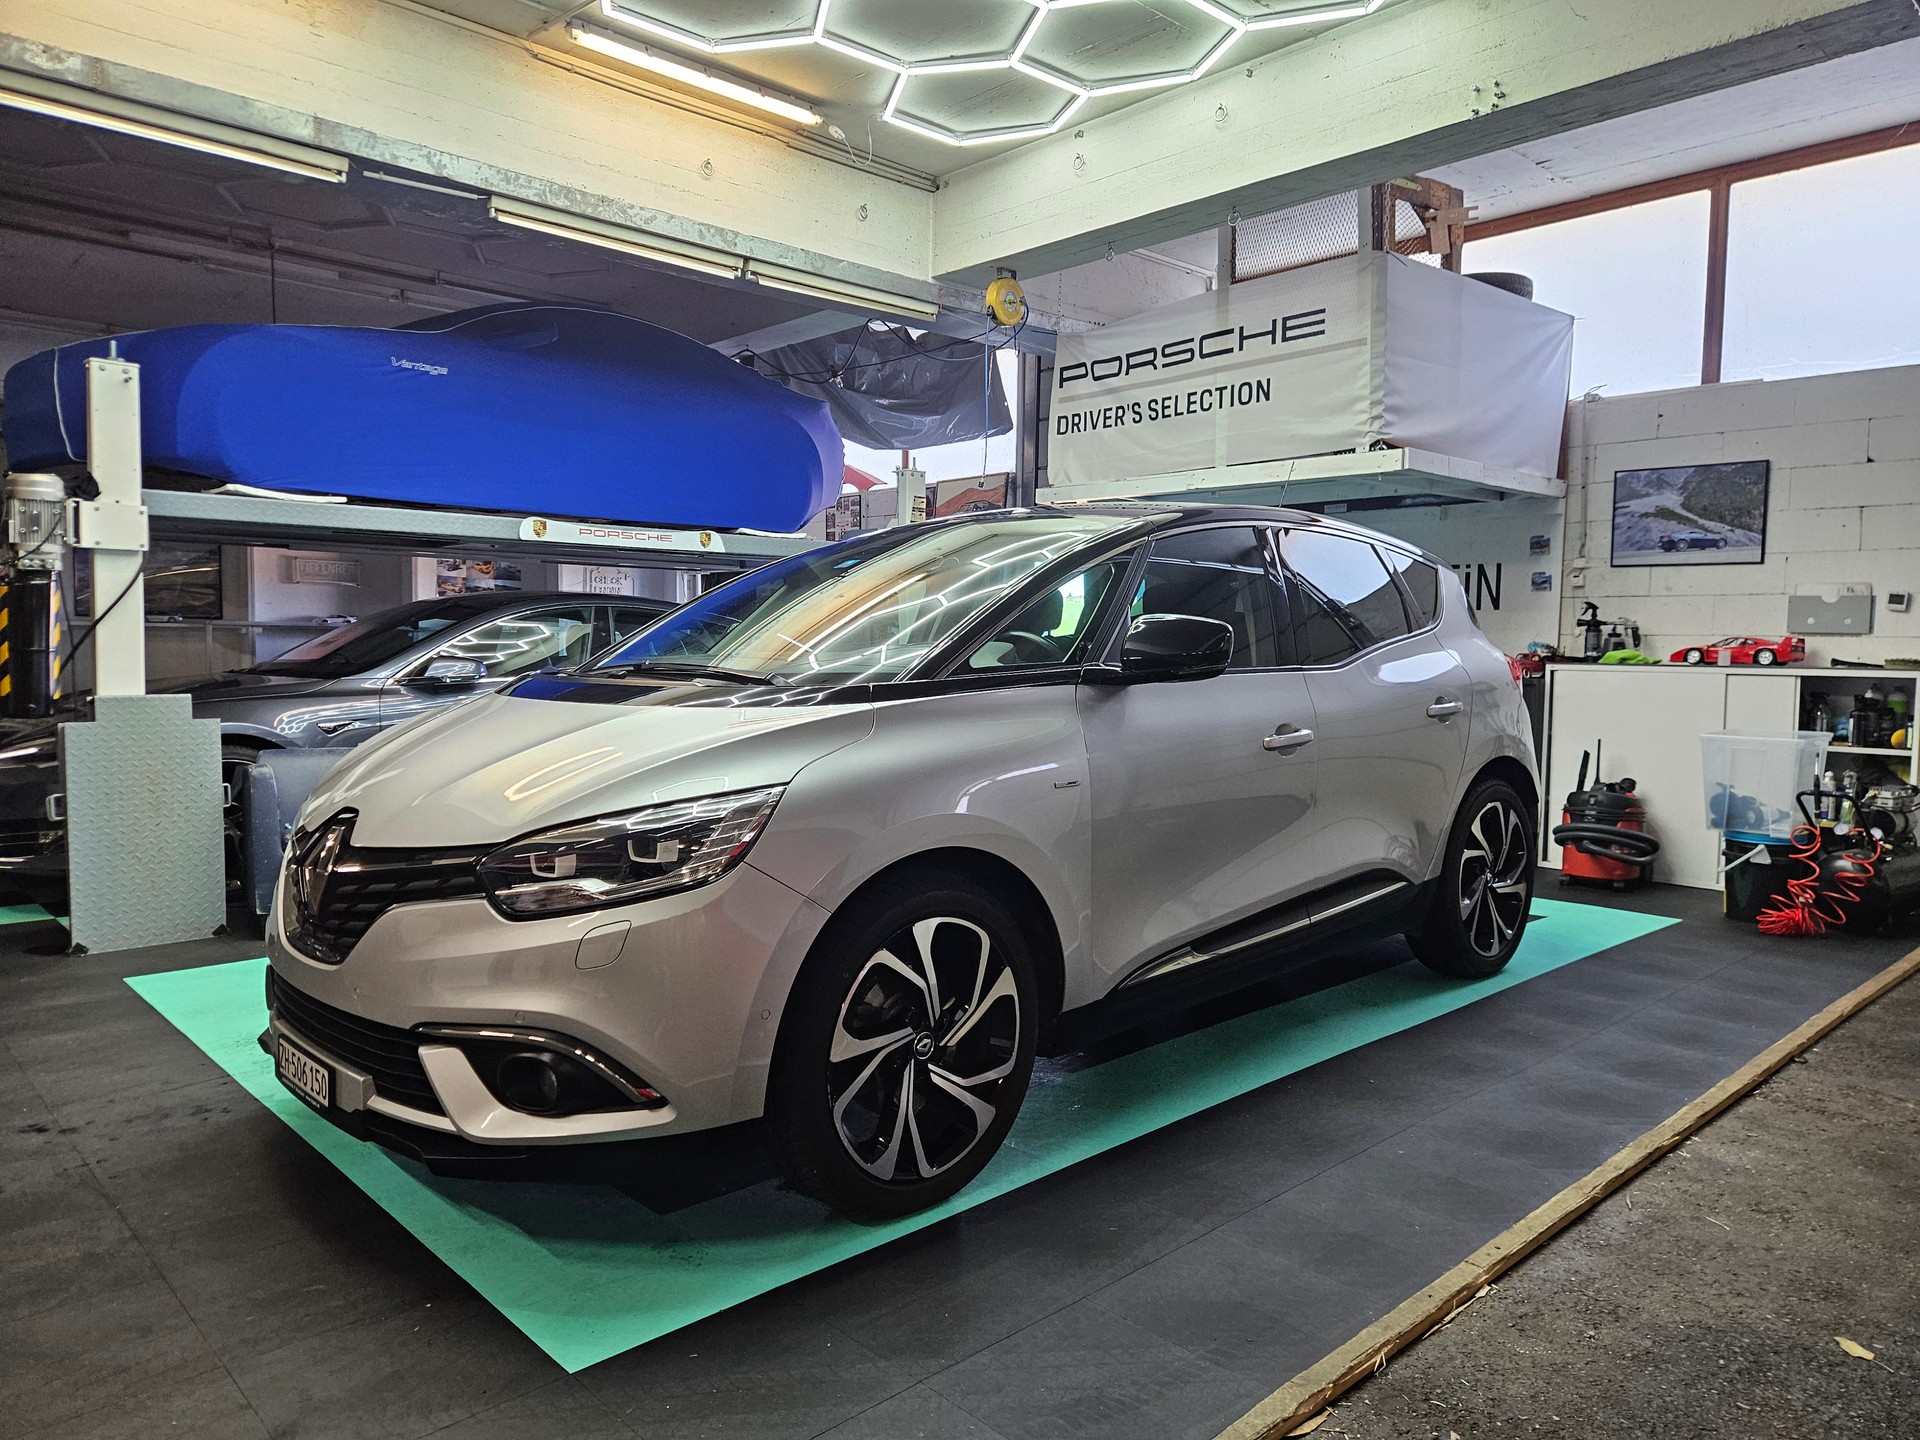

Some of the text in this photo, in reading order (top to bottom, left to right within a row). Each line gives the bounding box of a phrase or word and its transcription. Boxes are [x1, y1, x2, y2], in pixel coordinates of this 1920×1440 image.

[390, 356, 449, 375] Vantage
[1059, 308, 1326, 388] PORSCHE
[1056, 378, 1272, 436] DRIVER'S SELECTION
[578, 528, 673, 542] PORSCHE
